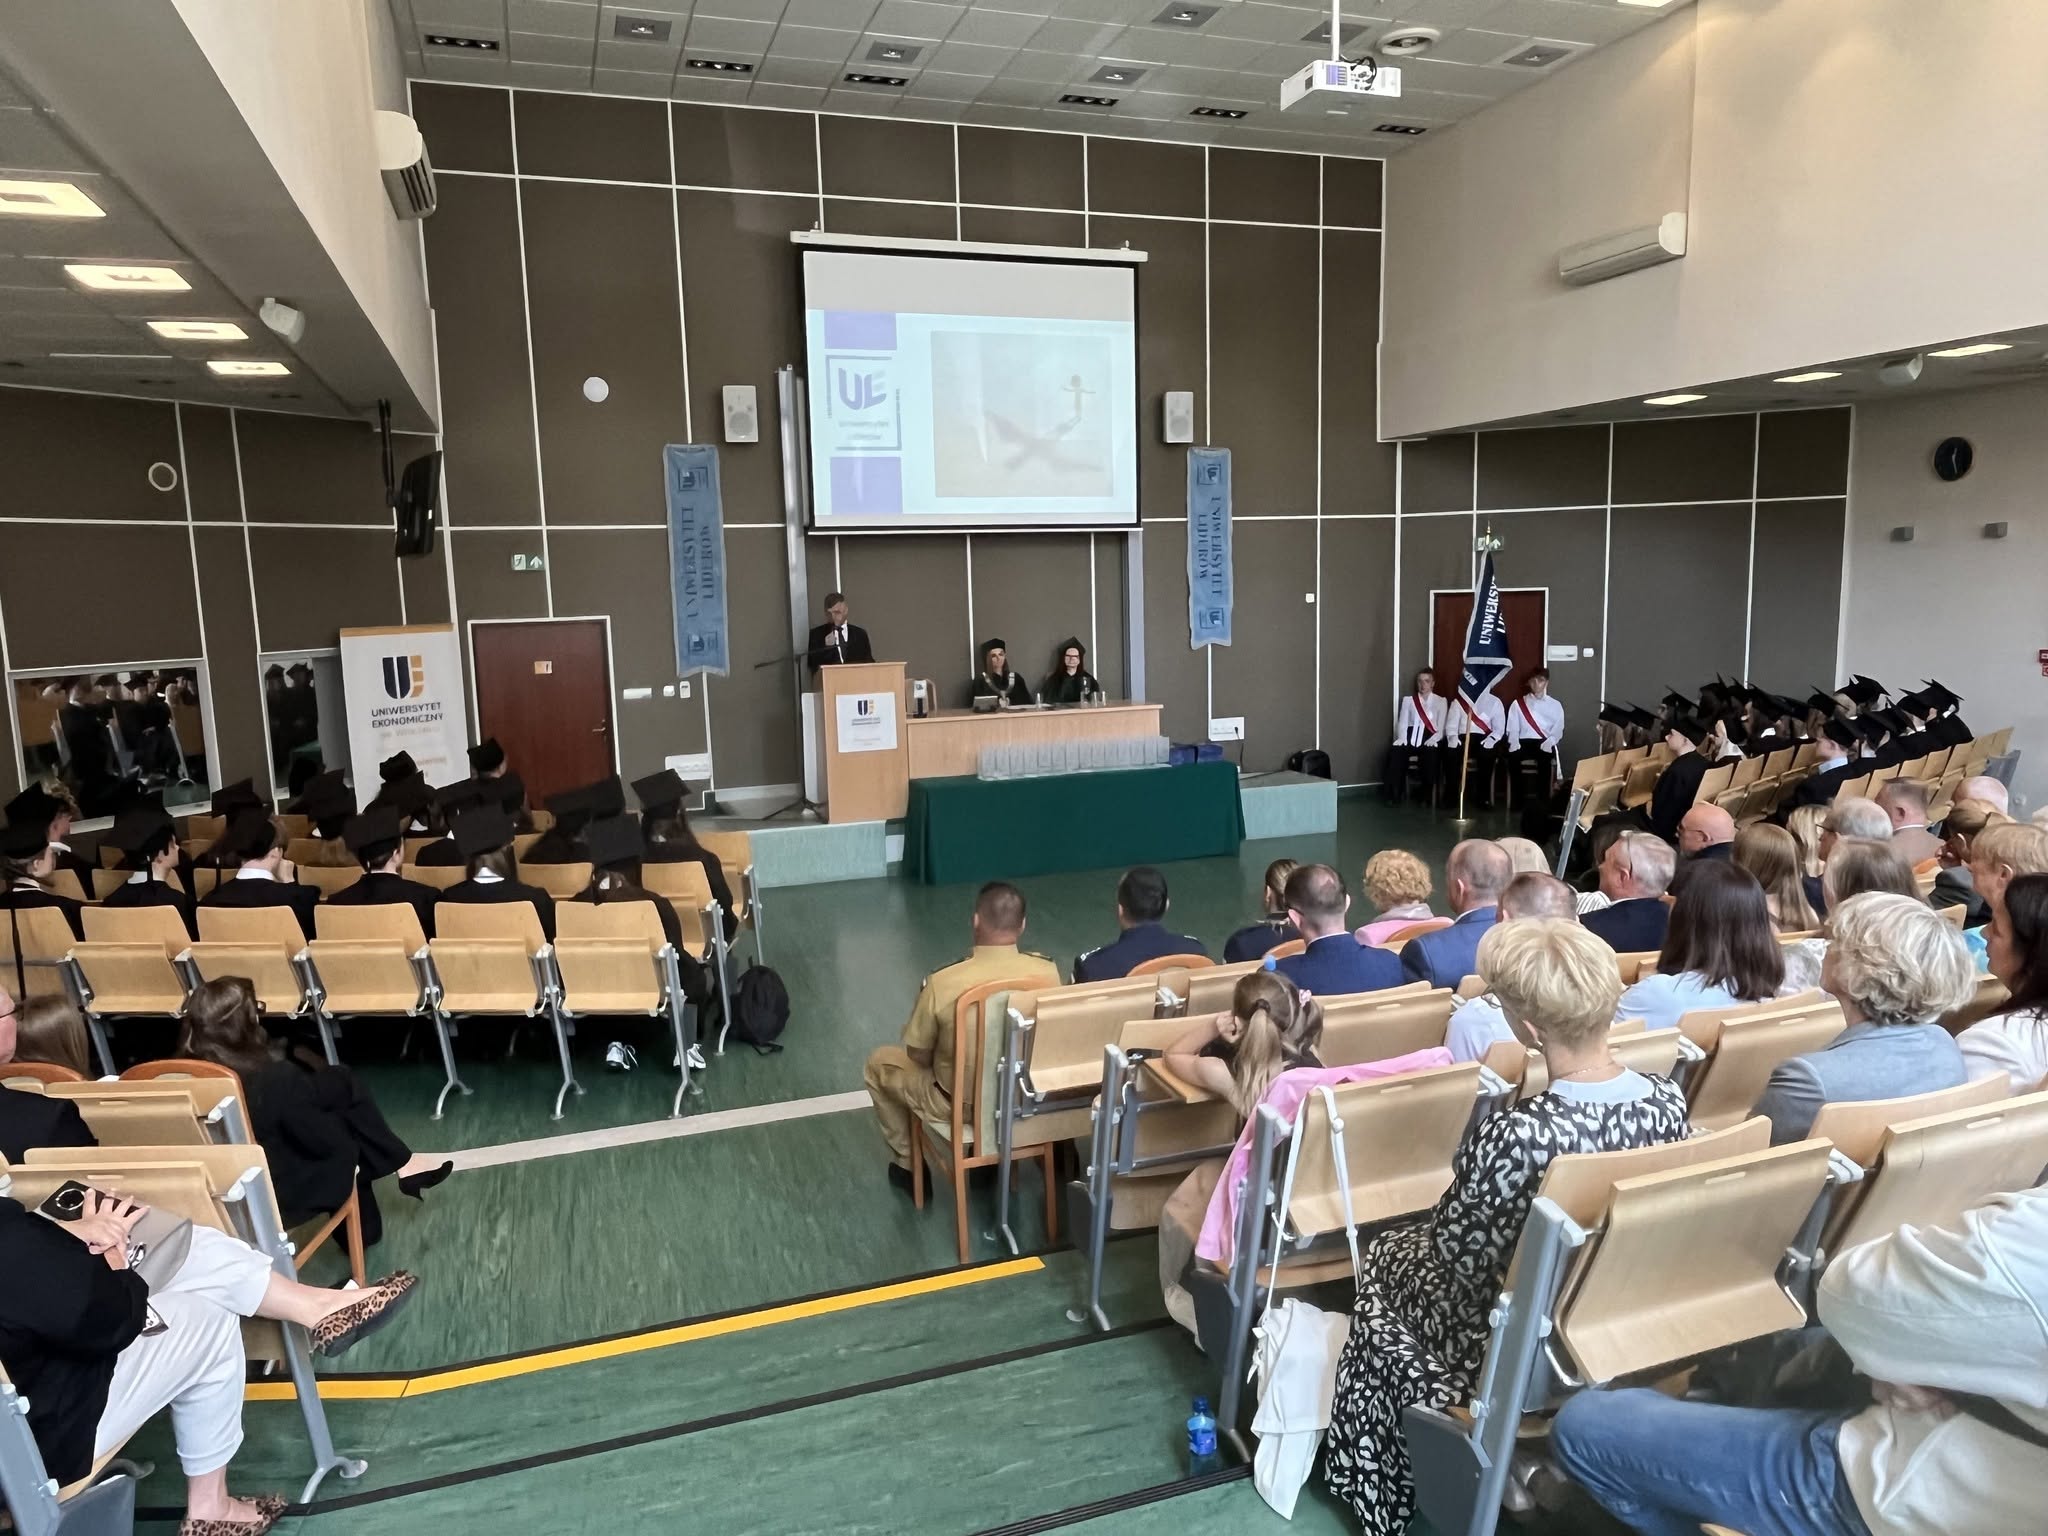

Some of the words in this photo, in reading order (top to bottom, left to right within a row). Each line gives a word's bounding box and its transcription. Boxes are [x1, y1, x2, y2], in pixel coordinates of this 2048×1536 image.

[1479, 576, 1500, 645] UNIWERSY
[371, 702, 441, 717] UNIWERSYTET
[371, 712, 443, 729] EKONOMICZNY
